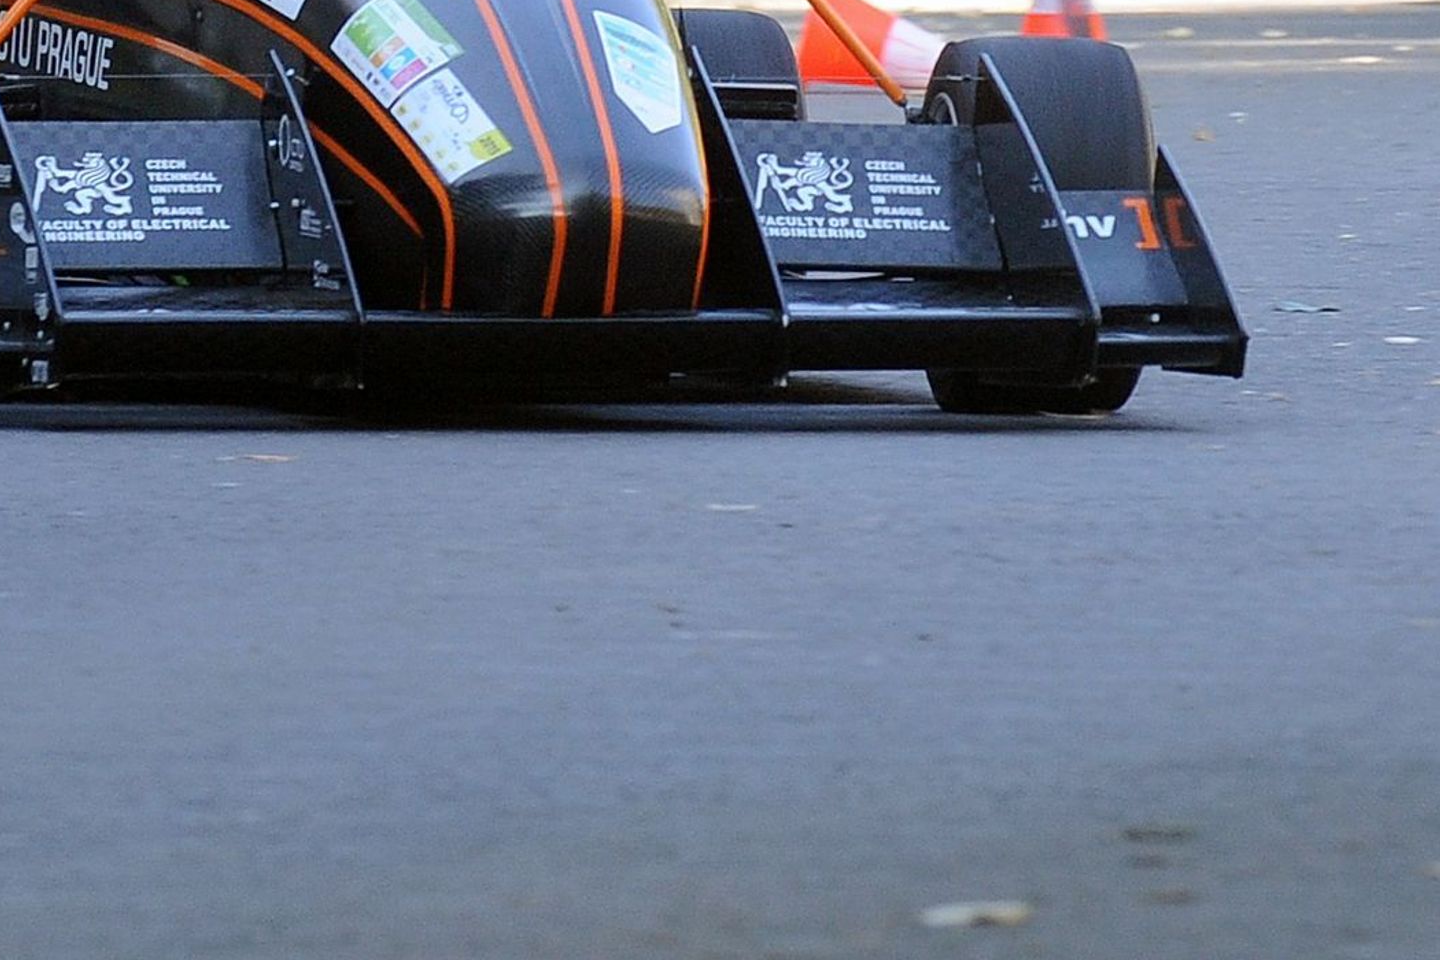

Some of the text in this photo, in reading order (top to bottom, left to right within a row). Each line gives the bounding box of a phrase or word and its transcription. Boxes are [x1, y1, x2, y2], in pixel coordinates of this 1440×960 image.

[36, 20, 114, 91] PRAGUE
[145, 159, 187, 170] CZECH
[864, 160, 905, 171] CZECH
[147, 171, 218, 182] TECHNICAL
[867, 172, 936, 183] TECHNICAL
[148, 183, 223, 194] UNIVERSITY
[868, 184, 942, 195] UNIVERSITY
[153, 207, 204, 216] PRAGUE
[873, 206, 923, 217] PRAGUE
[39, 219, 231, 231] ACULTY OF ELECTRICAL
[828, 218, 850, 228] OF
[853, 217, 951, 231] ELECTRICAL
[43, 230, 146, 242] NGINEERING
